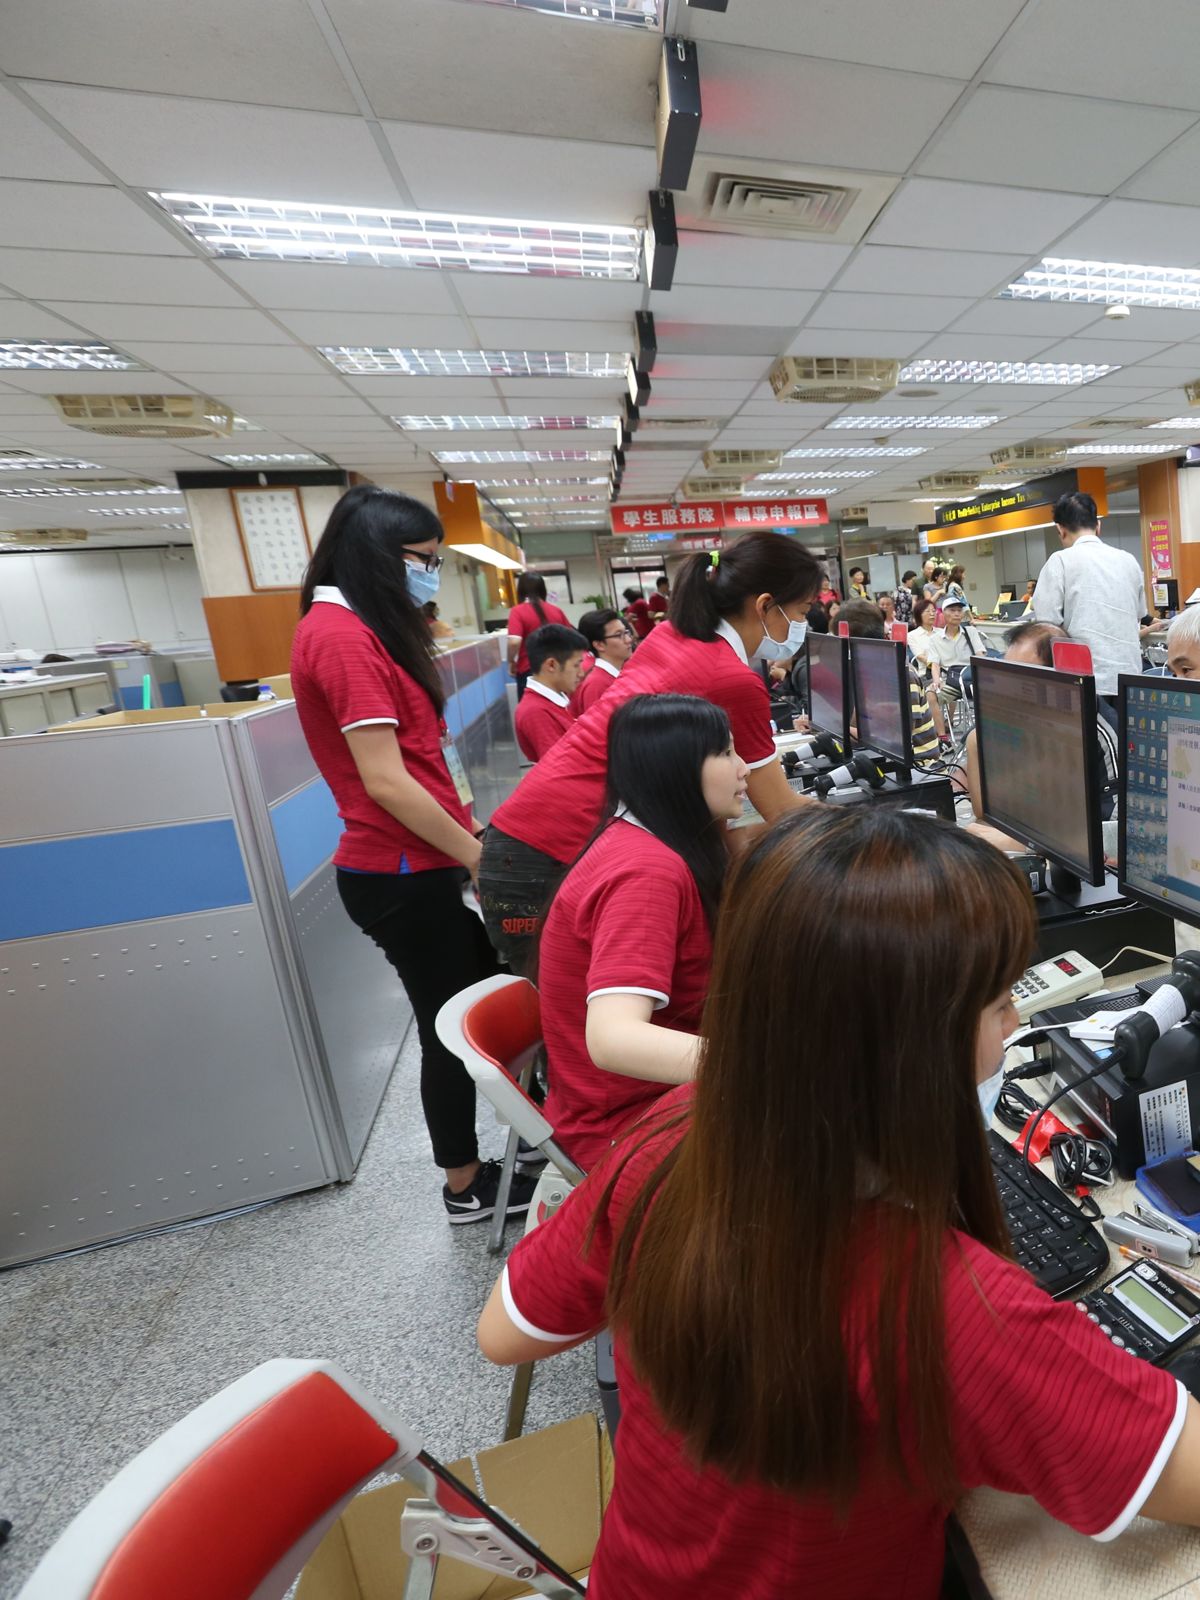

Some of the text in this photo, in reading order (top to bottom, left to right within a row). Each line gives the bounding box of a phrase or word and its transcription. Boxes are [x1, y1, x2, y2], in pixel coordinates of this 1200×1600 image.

[622, 507, 716, 528] 學生服務隊
[734, 503, 820, 523] 輔導申報區
